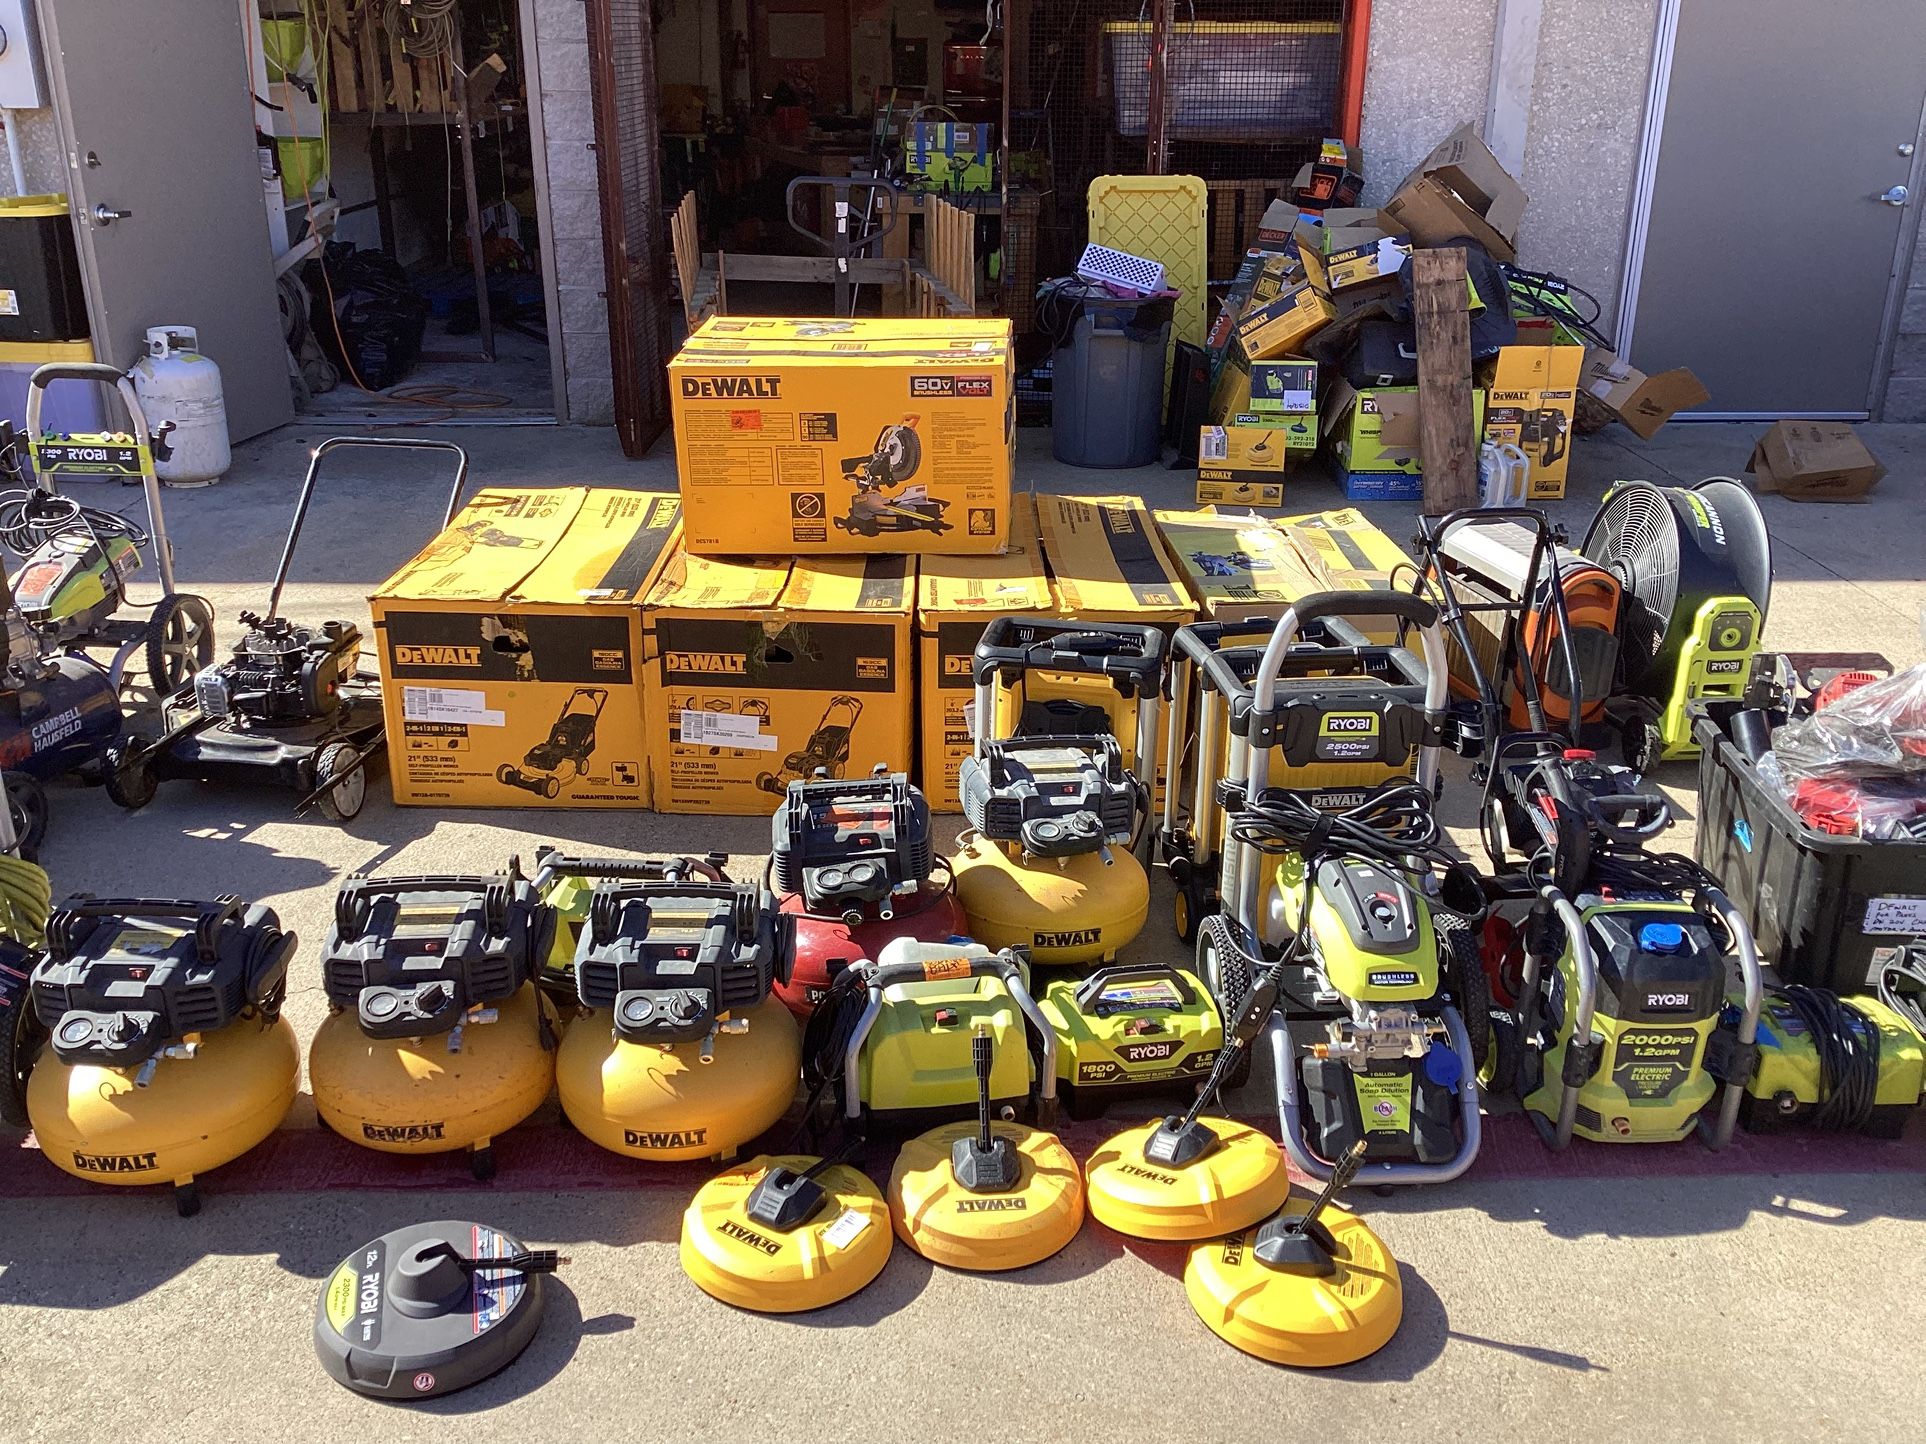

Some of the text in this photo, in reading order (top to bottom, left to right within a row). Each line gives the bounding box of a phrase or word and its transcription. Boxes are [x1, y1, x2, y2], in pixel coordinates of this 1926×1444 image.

[910, 155, 931, 164] RYBI
[1329, 250, 1358, 264] DEWALT
[1239, 312, 1268, 335] DEWALT
[681, 377, 781, 398] DEWALT
[914, 378, 952, 390] 60V
[958, 381, 990, 389] FLEX
[1493, 391, 1529, 400] DEWALT
[67, 448, 107, 460] RYOBI
[1200, 470, 1232, 480] DEWALT
[395, 646, 481, 665] DEWALT
[665, 653, 747, 672] DEWALT
[1711, 662, 1739, 671] RYOBI
[31, 706, 82, 739] CAMPBELL
[1329, 718, 1370, 730] RYOBI
[34, 720, 82, 753] HAUSFELD
[684, 761, 699, 769] (533
[1311, 793, 1366, 807] DEWALT
[1034, 929, 1102, 947] DEWALT
[1648, 994, 1689, 1006] RYOBI
[1620, 1034, 1695, 1045] 2000PSI
[1129, 1044, 1170, 1059] RYOBI
[1196, 1053, 1214, 1061] 1.2
[1633, 1048, 1680, 1056] 1.2GPM
[1081, 1064, 1115, 1073] 1800
[1194, 1060, 1214, 1069] GPM
[1090, 1071, 1106, 1079] PSI
[1631, 1073, 1672, 1081] ELECTRIC
[363, 1123, 445, 1142] DEWALT
[624, 1129, 707, 1148] DEWALT
[73, 1152, 158, 1172] DEWALT
[1117, 1164, 1178, 1186] DEWALT
[957, 1198, 1027, 1213] DEWALT
[717, 1220, 783, 1256] DEWALT
[360, 1272, 380, 1314] RYOBI
